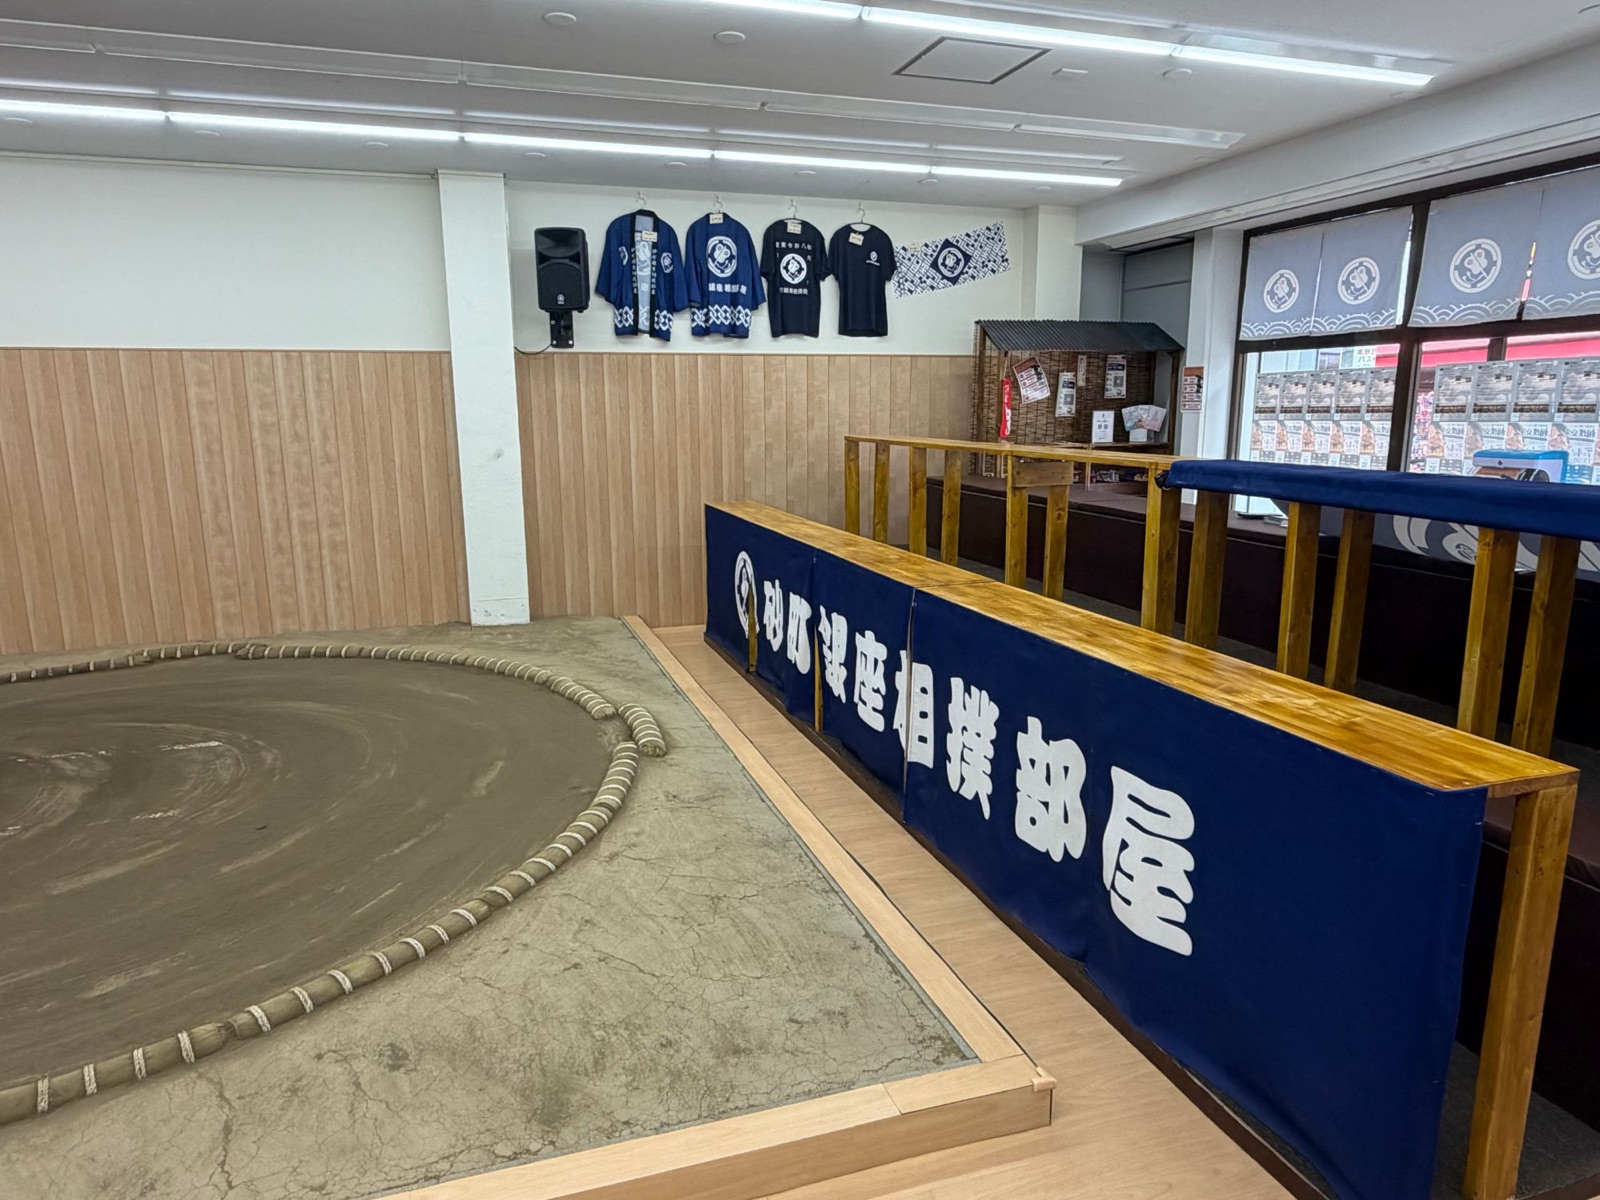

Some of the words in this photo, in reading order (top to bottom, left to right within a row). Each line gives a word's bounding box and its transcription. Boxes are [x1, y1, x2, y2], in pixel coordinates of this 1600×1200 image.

[763, 579, 1195, 956] 砂町銀座相撲部屋
